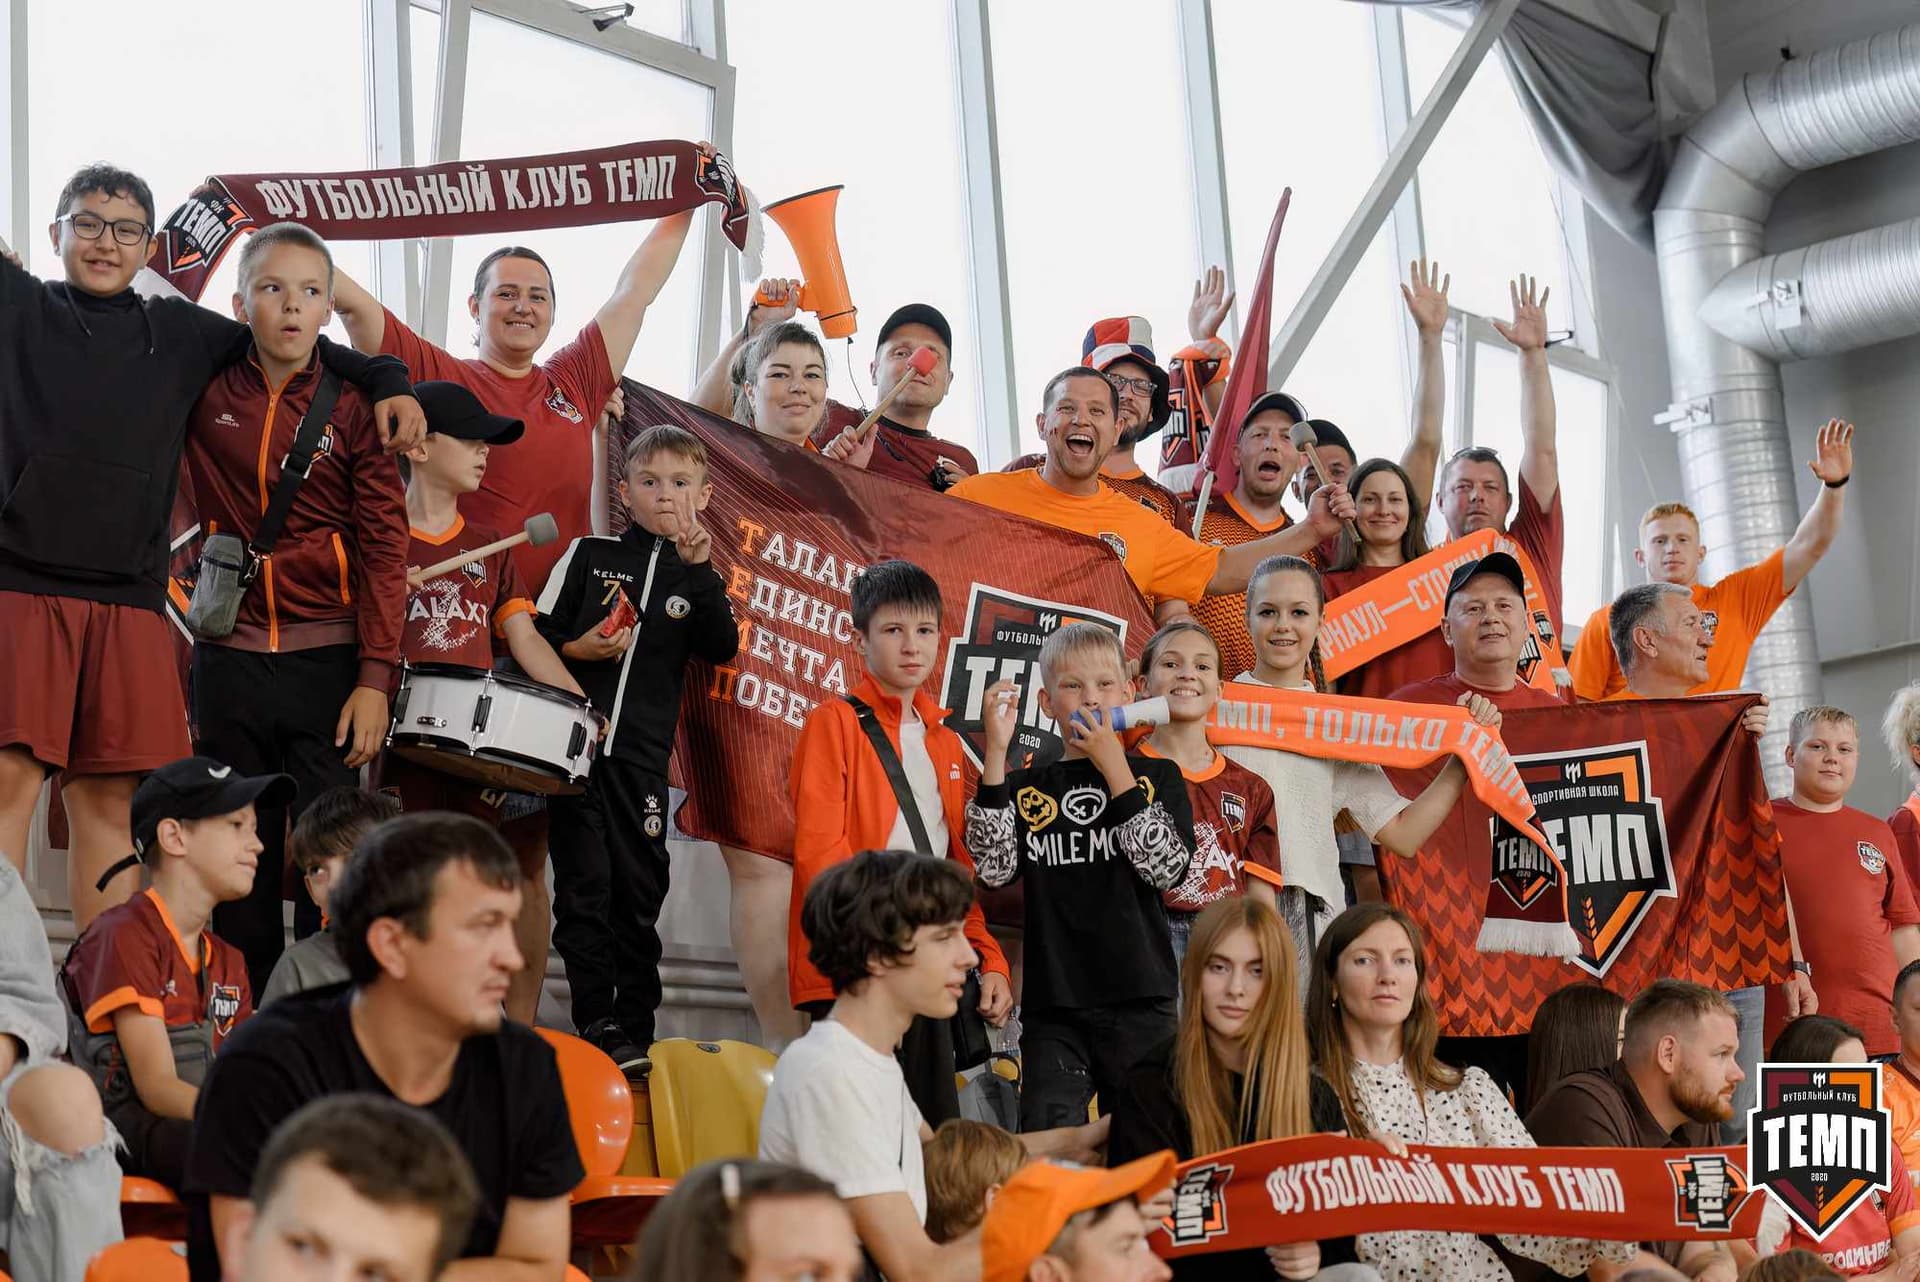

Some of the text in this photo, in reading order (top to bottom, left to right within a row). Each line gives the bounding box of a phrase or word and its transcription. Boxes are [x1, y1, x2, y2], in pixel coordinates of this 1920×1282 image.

[256, 164, 496, 220] ФУТБОЛЬНЫЙ
[500, 164, 592, 210] КЛУБ
[600, 155, 676, 203] ТЕМП
[174, 198, 227, 255] ТЕМП
[593, 568, 634, 583] KELME
[601, 580, 621, 606] 7
[404, 596, 489, 628] ALAXY
[708, 665, 823, 730] ПОБЕ
[1019, 733, 1041, 749] 2020
[1303, 706, 1447, 751] ТОЛЬКО
[1532, 784, 1620, 806] СПОРТИВНАЯ ШКОЛА
[1026, 832, 1085, 867] SMILE
[1541, 814, 1655, 885] ЕМП
[1176, 1170, 1213, 1238] ТЕМП
[1265, 1153, 1626, 1214] ФУТБОЛЬНЫЙ КЛУБ ТЕМП
[1693, 1160, 1726, 1225] ТЕМП
